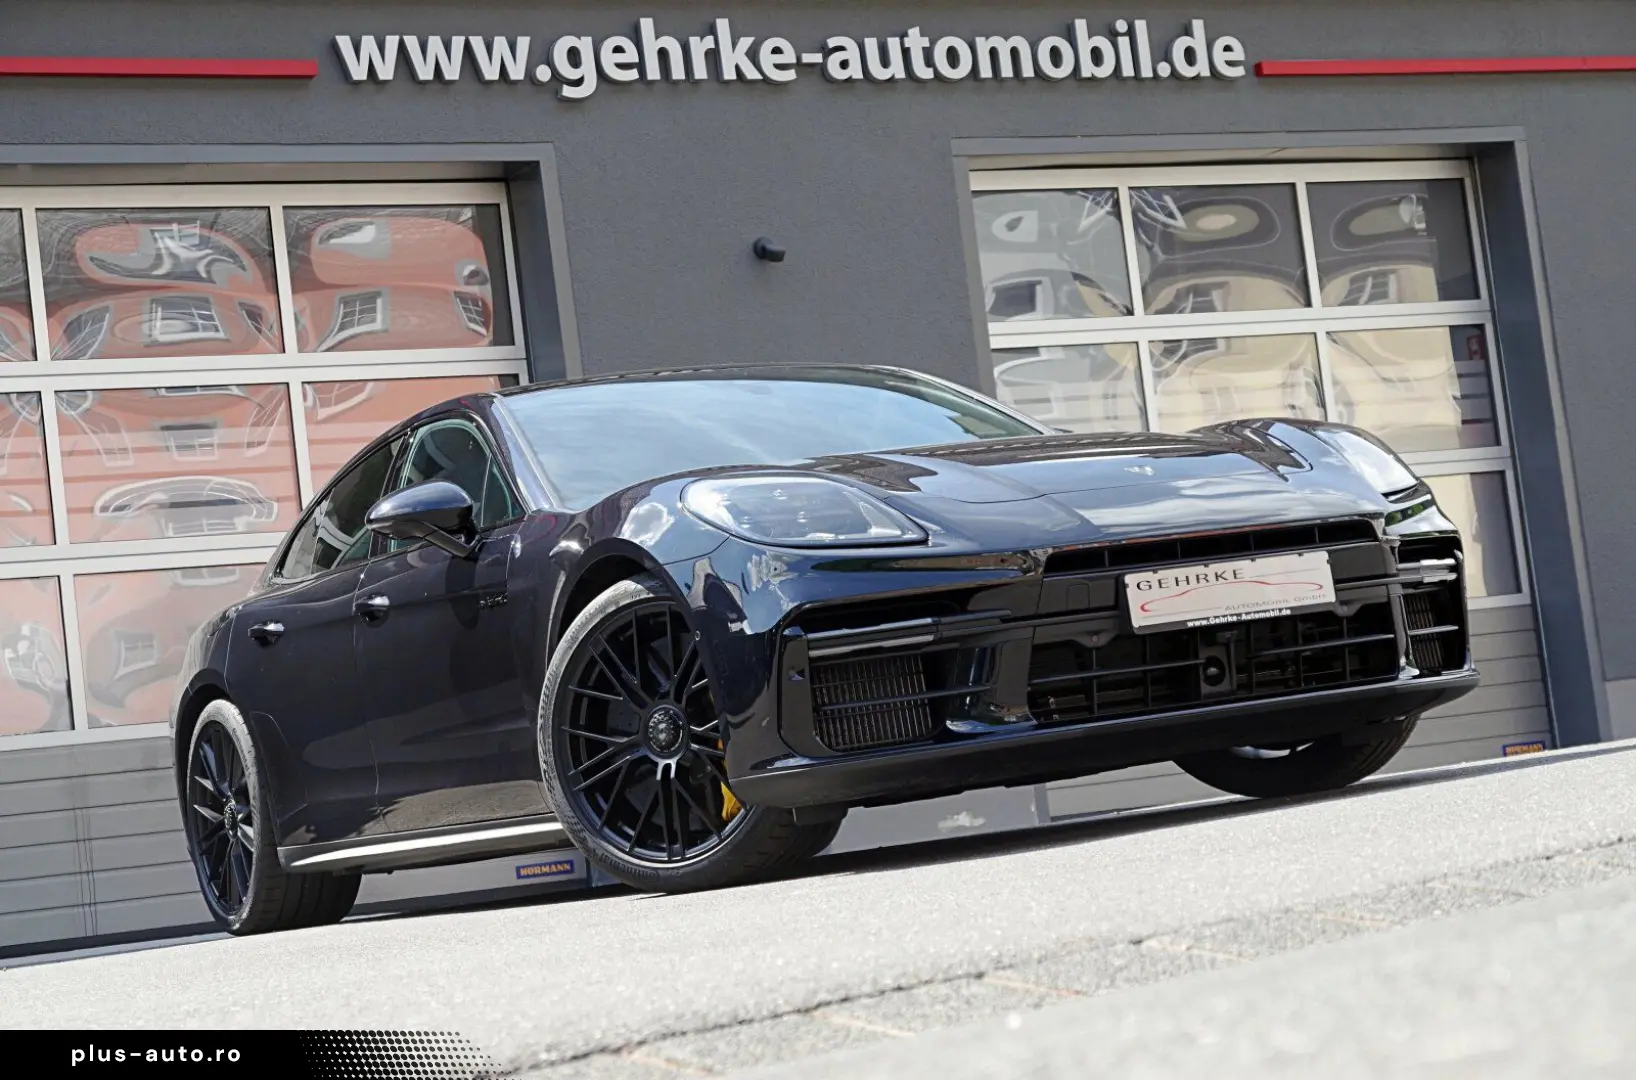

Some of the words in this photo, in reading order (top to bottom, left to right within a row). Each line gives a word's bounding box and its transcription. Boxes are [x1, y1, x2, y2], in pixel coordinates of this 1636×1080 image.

[336, 17, 1247, 100] www.gehrke-automobil.de
[1136, 568, 1245, 591] GEHRKE
[1187, 608, 1292, 628] www.Gehrke-Automobil.de
